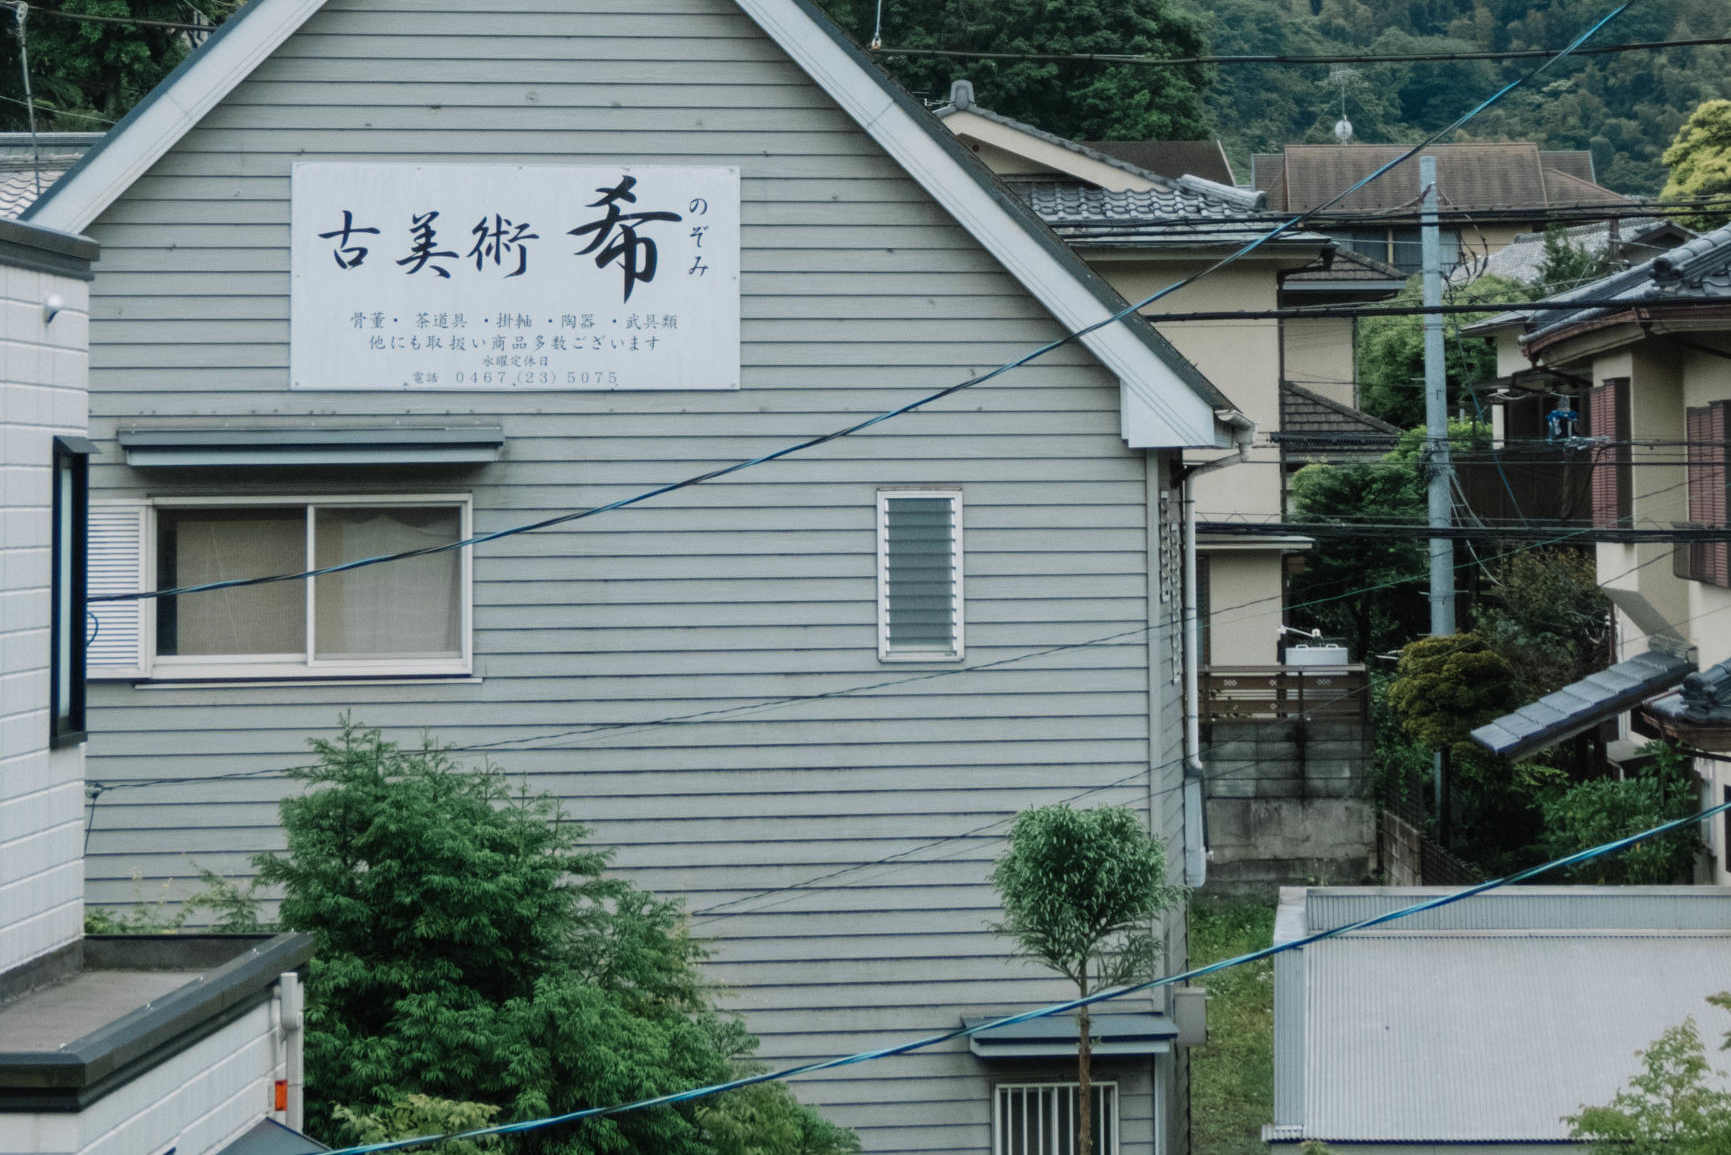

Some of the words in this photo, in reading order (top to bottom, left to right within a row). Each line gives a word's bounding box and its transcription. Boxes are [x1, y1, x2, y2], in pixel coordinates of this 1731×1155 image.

[317, 209, 541, 280] 古美術
[565, 174, 684, 305] 希
[688, 197, 710, 278] のぞみ
[369, 333, 661, 352] 他にも取扱い商品多数ございます
[483, 354, 549, 369] 水曜定休日
[412, 371, 439, 384] 電話
